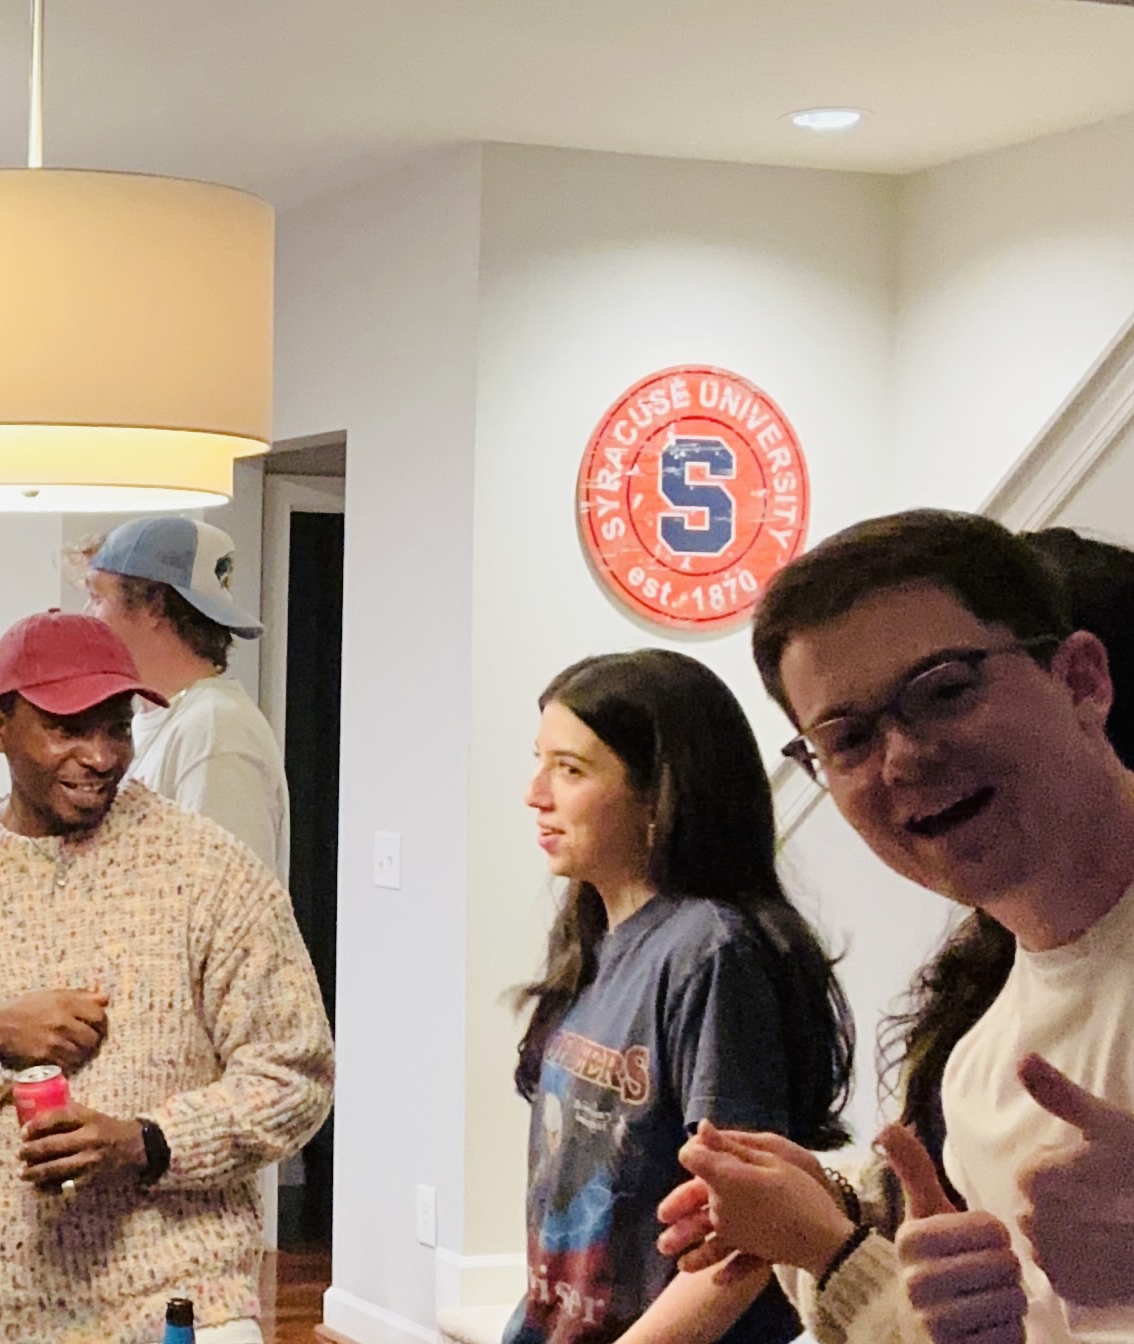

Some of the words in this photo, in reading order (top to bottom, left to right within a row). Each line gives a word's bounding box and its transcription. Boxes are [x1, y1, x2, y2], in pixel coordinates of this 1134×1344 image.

[596, 378, 691, 541] SYRACUSE
[699, 379, 797, 550] UNIVERSITY
[659, 436, 736, 556] S
[690, 569, 758, 612] 1870
